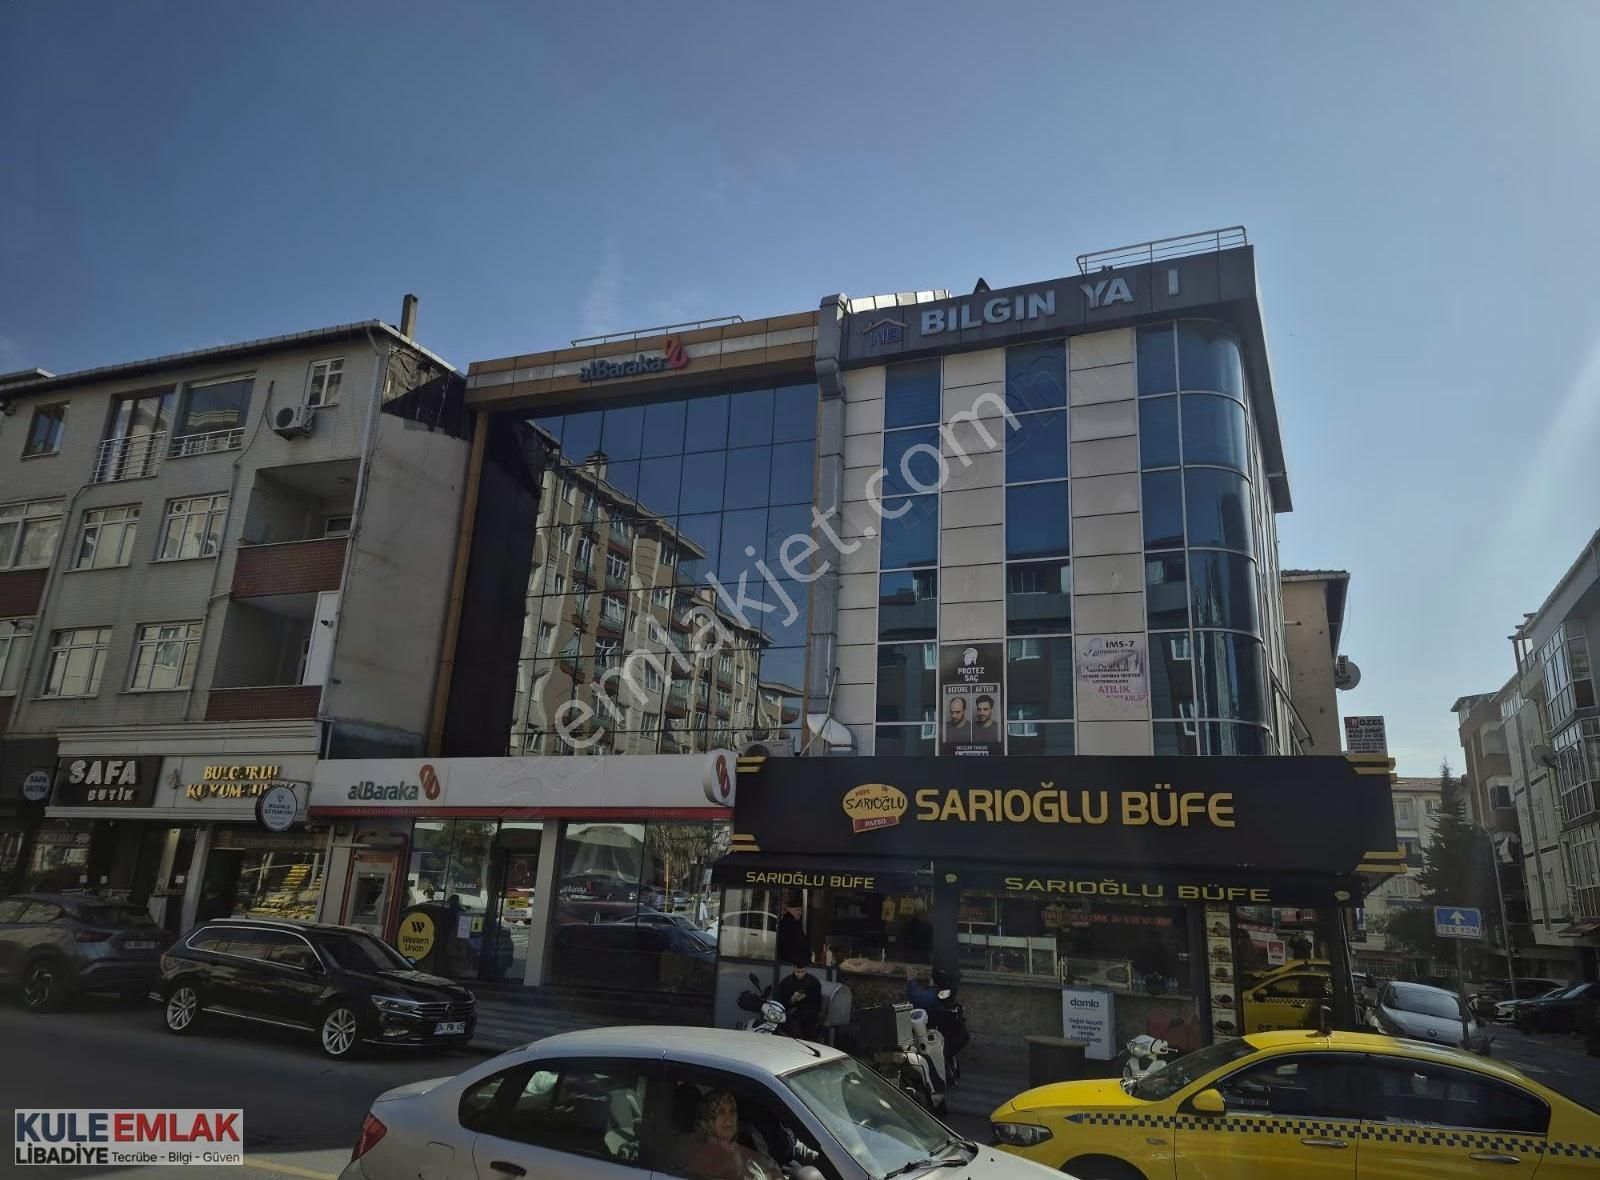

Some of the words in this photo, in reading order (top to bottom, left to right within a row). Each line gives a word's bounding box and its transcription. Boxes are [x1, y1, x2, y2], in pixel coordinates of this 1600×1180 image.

[579, 354, 666, 382] alBaraka
[958, 666, 985, 675] PROTEZ
[69, 759, 136, 785] SAFA
[88, 786, 135, 801] BUTİK
[347, 781, 419, 801] alBaraka
[914, 781, 1110, 825] SARIOĞLU
[1121, 783, 1236, 828] BÜFE
[745, 871, 825, 887] SARIOĞLU
[830, 874, 876, 889] BÜFE
[1004, 877, 1164, 898] SARIOĞLU
[1177, 884, 1272, 902] BÜFE
[402, 936, 430, 945] Western
[405, 944, 424, 953] Union
[1070, 998, 1100, 1008] damla
